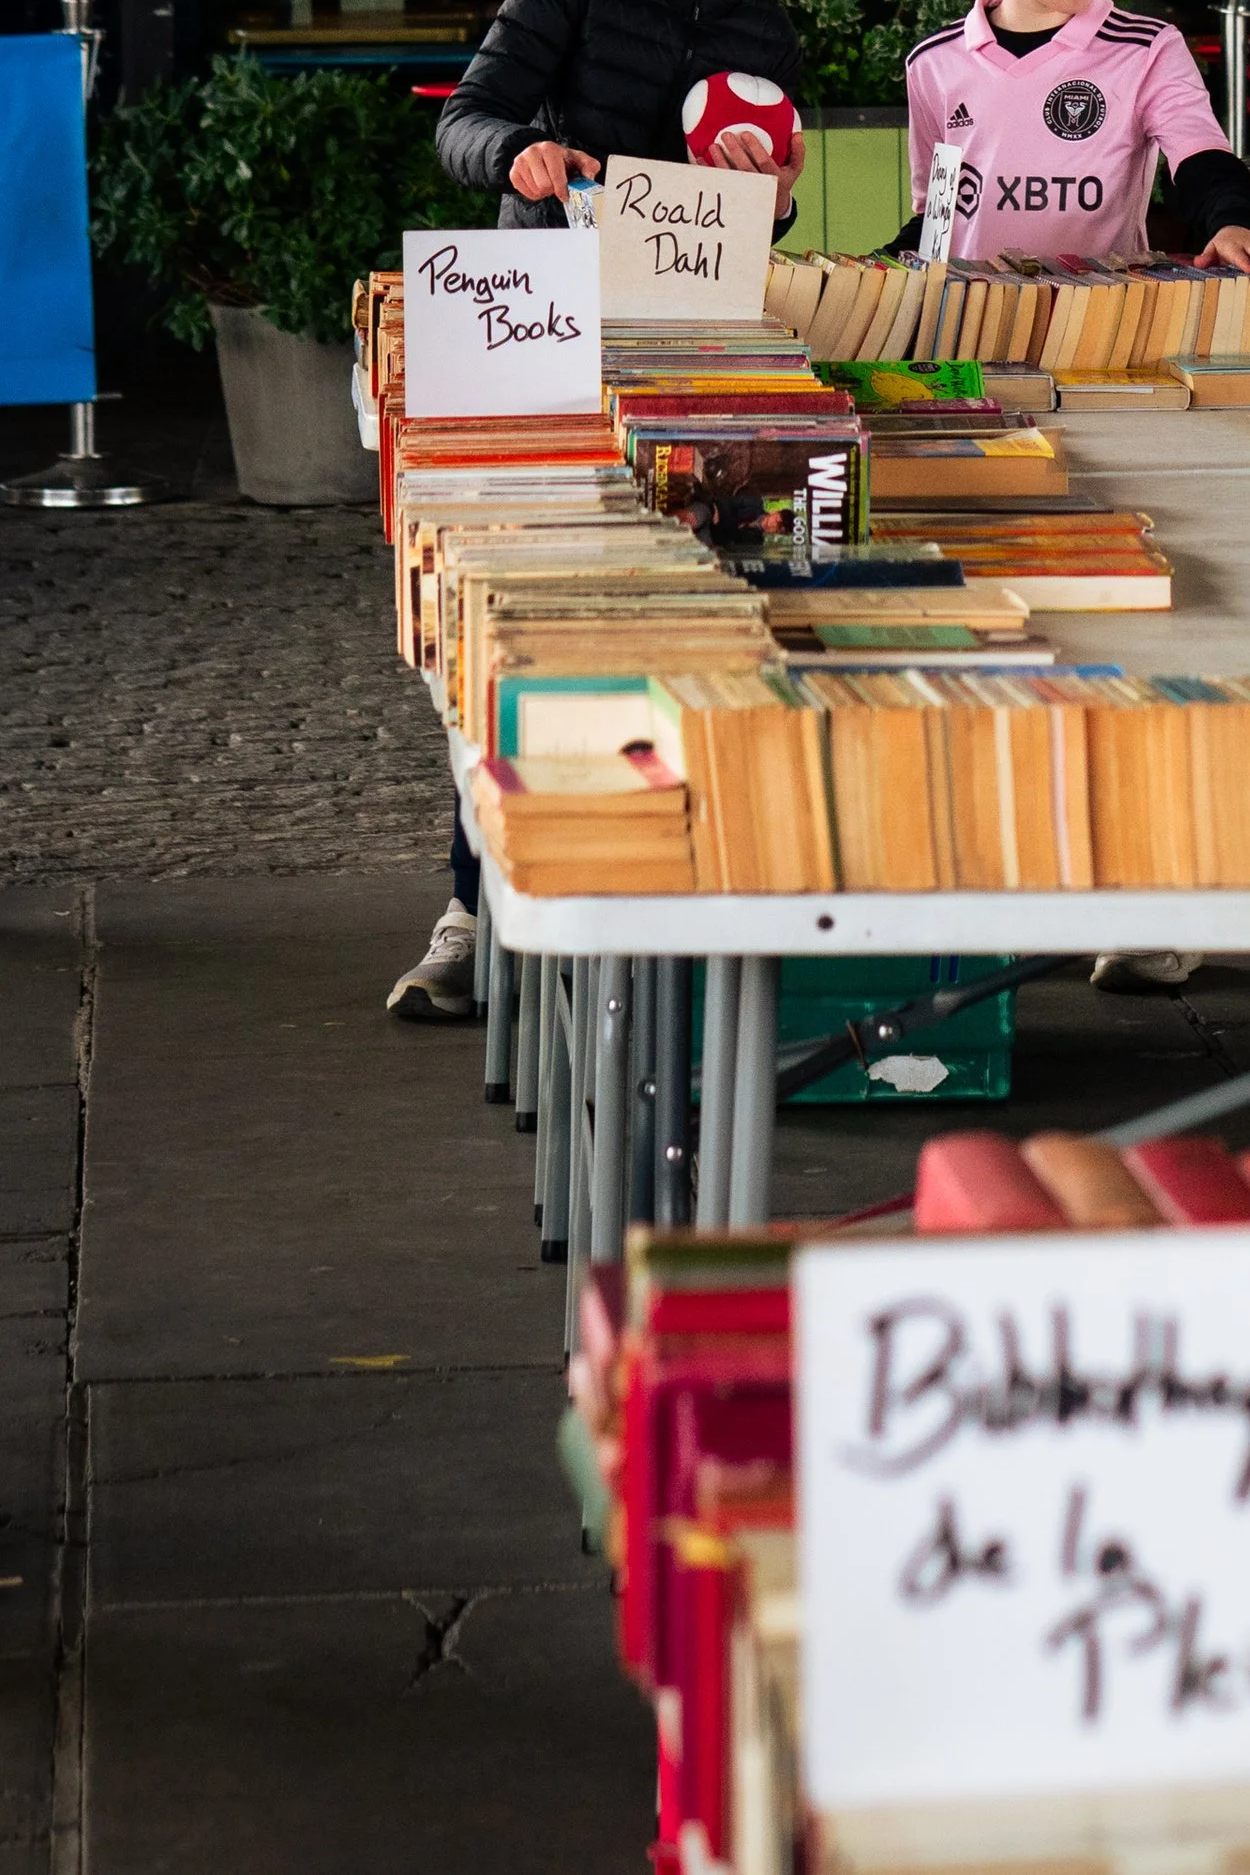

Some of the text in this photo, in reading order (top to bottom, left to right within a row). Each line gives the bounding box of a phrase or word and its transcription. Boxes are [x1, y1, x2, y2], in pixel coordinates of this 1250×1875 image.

[1046, 80, 1098, 105] INTERNACIONAL
[1063, 94, 1090, 102] MIAMI
[1096, 92, 1104, 102] DE
[946, 116, 974, 130] adidas
[1044, 107, 1053, 125] CLUB
[1061, 131, 1083, 140] MMXX
[616, 172, 725, 228] Roald
[996, 175, 1103, 212] XBTO
[644, 231, 722, 281] Dahl
[418, 245, 533, 303] Penguin
[478, 301, 581, 350] Books
[793, 488, 808, 513] THE
